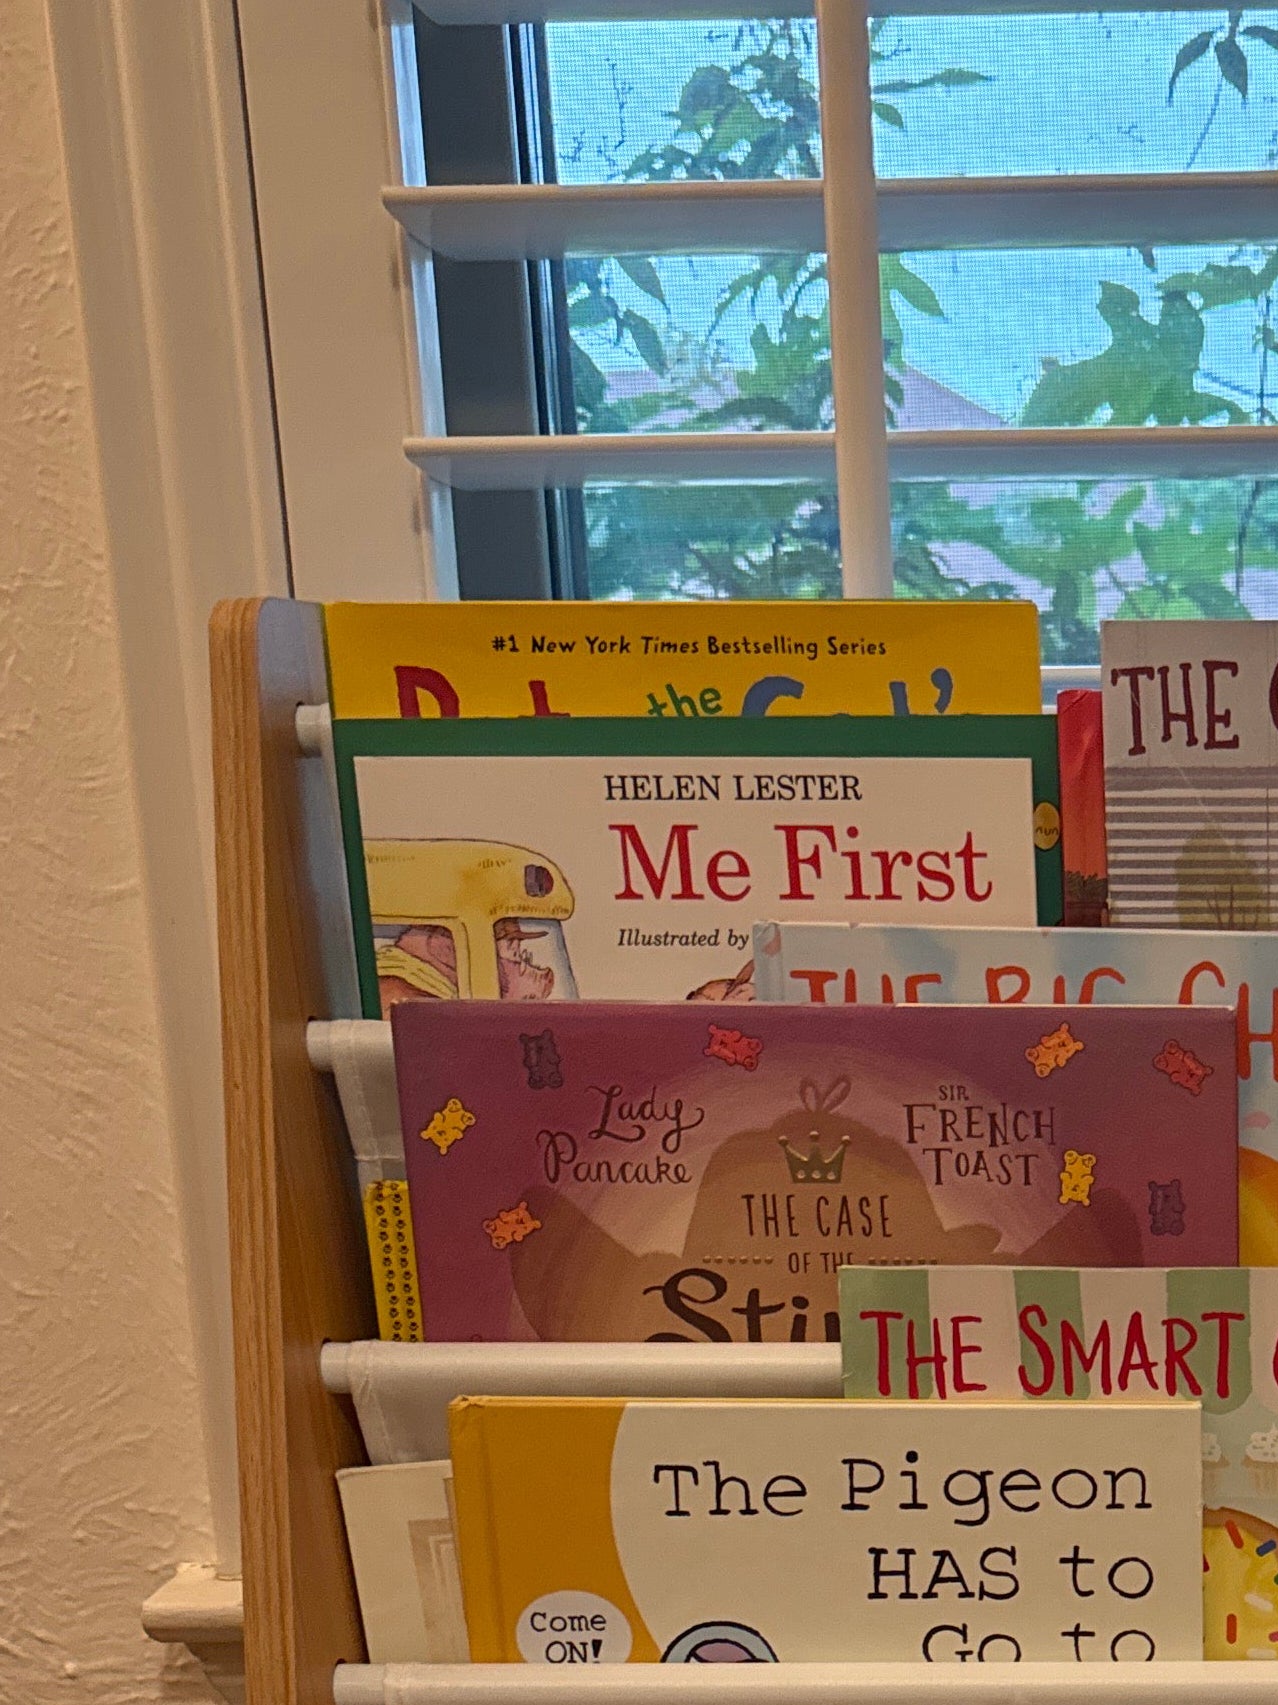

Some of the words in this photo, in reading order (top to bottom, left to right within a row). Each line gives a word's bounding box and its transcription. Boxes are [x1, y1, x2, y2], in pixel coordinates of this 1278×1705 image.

[492, 635, 520, 653] #1
[531, 635, 576, 653] New
[585, 635, 631, 655] York
[641, 636, 699, 655] Times
[707, 636, 818, 661] Bestselling
[827, 636, 887, 655] Series
[1110, 660, 1239, 755] THE
[604, 775, 722, 801] HELEN
[733, 775, 864, 801] LESTER
[609, 824, 752, 902] Me
[774, 824, 993, 902] First
[618, 929, 720, 948] Illustrated
[727, 929, 750, 951] by
[939, 1084, 970, 1101] SIR
[585, 1085, 705, 1154] Lady
[902, 1103, 1057, 1147] FRENCH
[536, 1129, 693, 1184] Pancake
[923, 1147, 1040, 1187] TOAST
[741, 1193, 796, 1238] THE
[816, 1194, 894, 1238] CASE
[788, 1252, 811, 1274] OF
[859, 1309, 988, 1399] THE
[1018, 1304, 1246, 1400] SMART
[653, 1460, 808, 1517] The
[841, 1450, 1152, 1526] Pigeon
[868, 1547, 1018, 1601] HAS
[1060, 1546, 1154, 1600] to
[530, 1612, 606, 1632] Come
[1060, 1623, 1155, 1662] to
[545, 1639, 603, 1663] ON!
